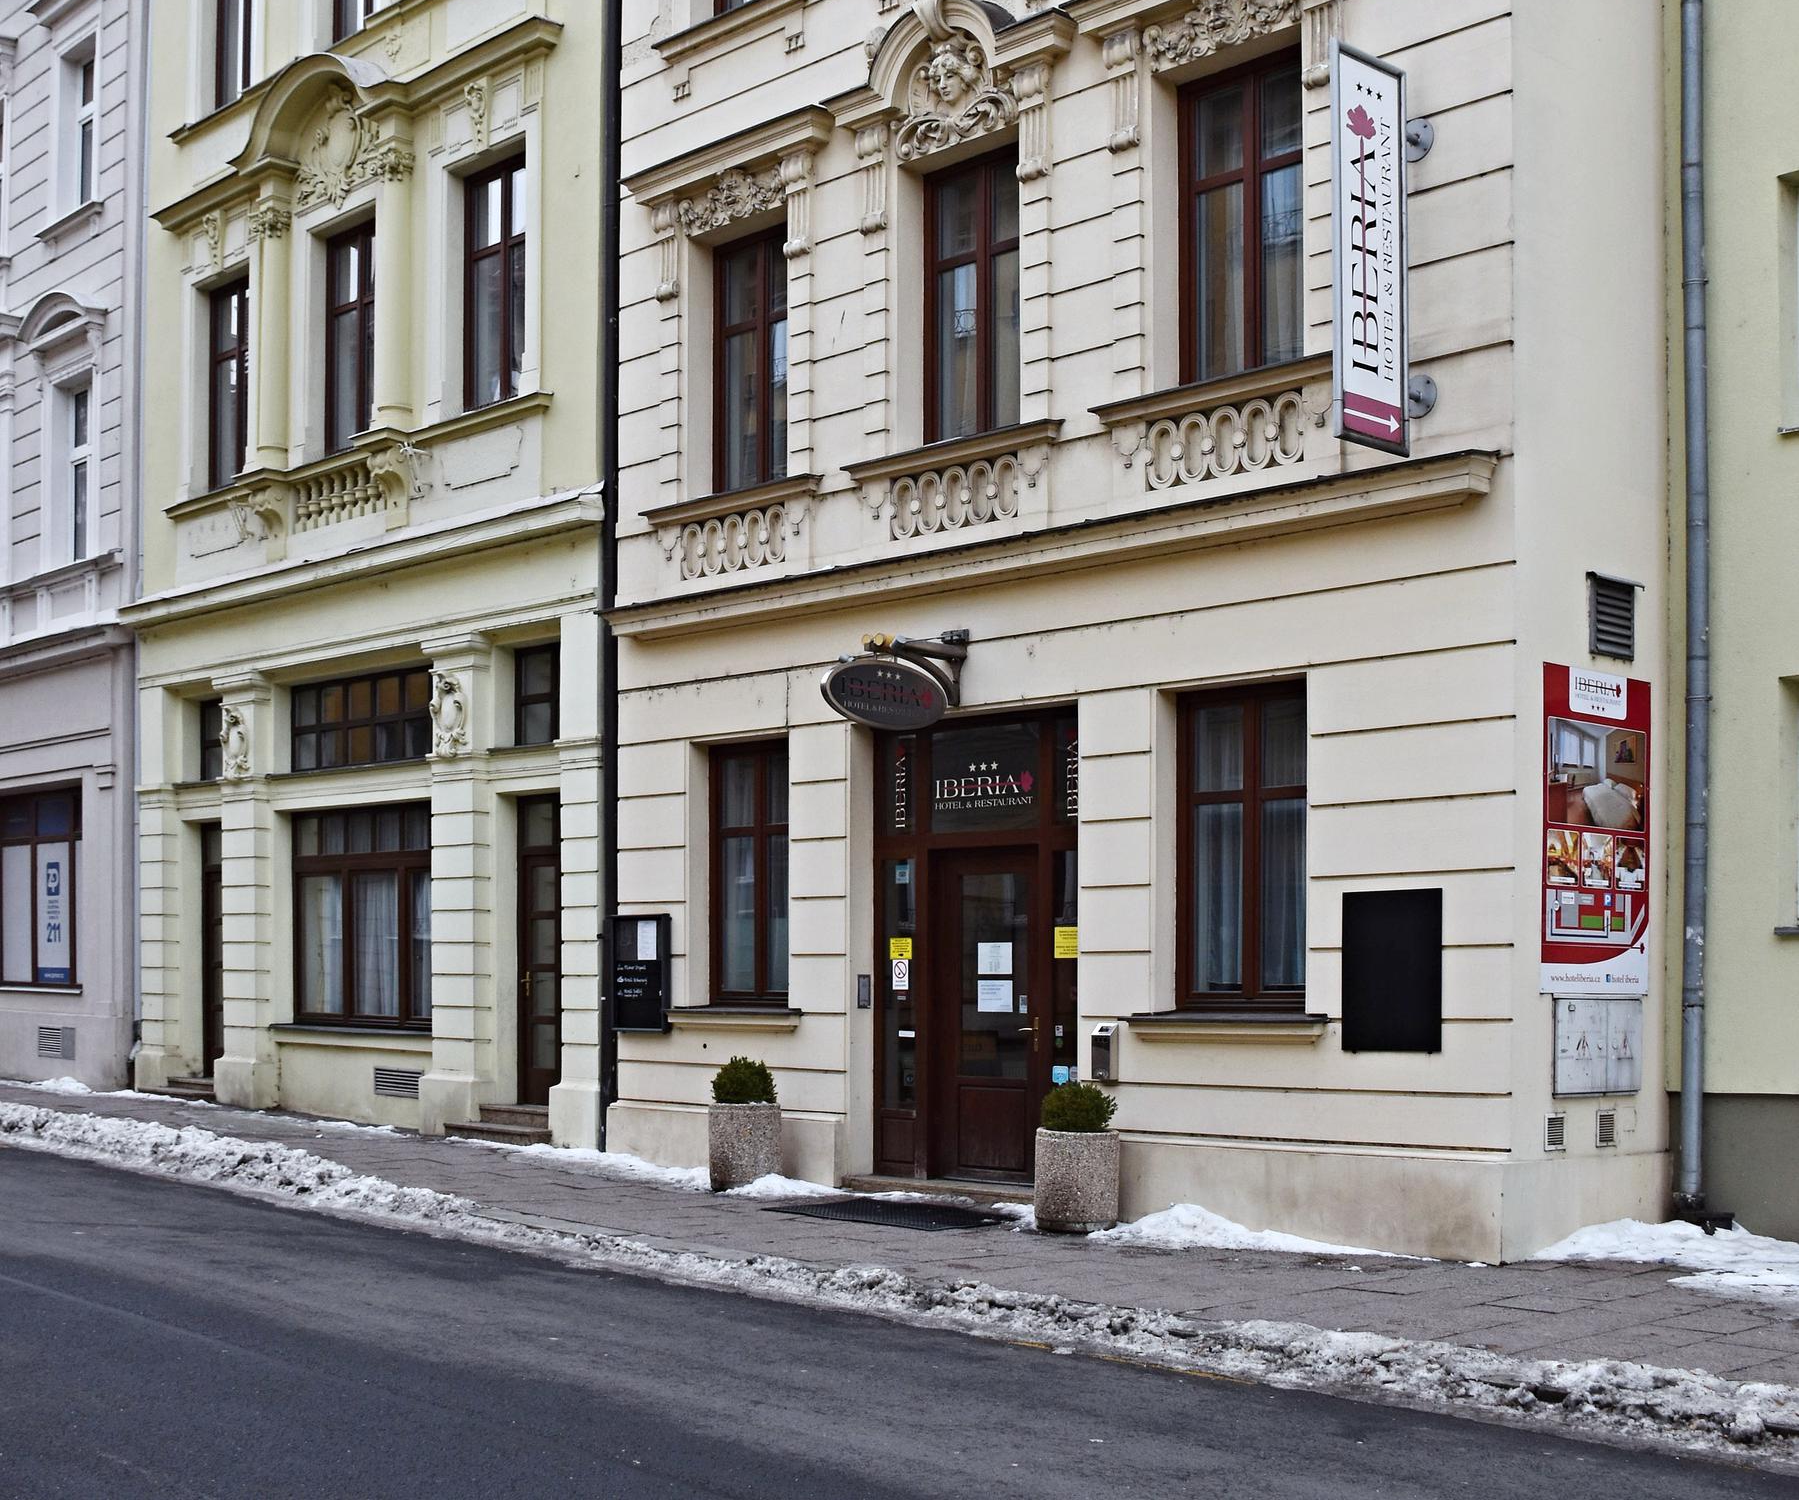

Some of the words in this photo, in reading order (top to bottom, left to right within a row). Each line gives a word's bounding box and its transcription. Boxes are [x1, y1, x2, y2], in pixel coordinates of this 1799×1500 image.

[1381, 116, 1393, 276] RESTAURANT
[1351, 150, 1379, 378] IBERIA
[1384, 285, 1393, 297] &
[1384, 304, 1394, 383] HOTEL
[841, 676, 920, 707] IBERIA
[1574, 676, 1615, 698] IBERIA
[895, 756, 906, 828] IBERIA
[935, 775, 1019, 799] IBERIA
[1067, 739, 1078, 817] IBERIA
[935, 802, 964, 810] HOTEL
[974, 796, 1034, 808] RESTAURANT
[47, 922, 61, 943] 211
